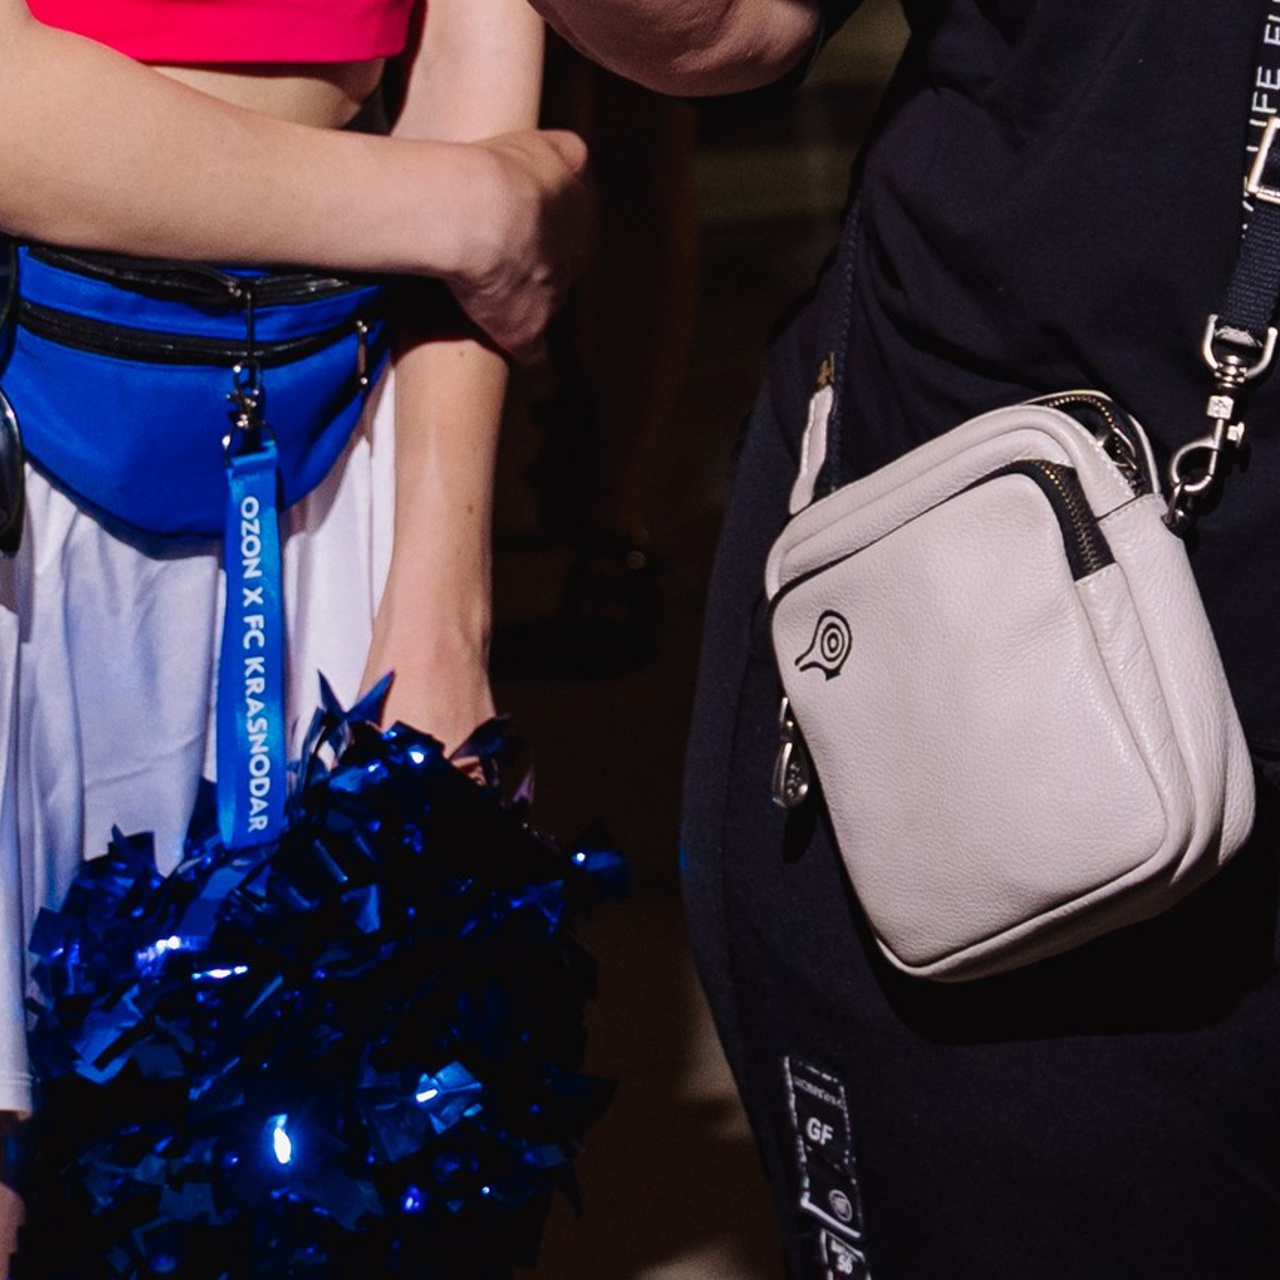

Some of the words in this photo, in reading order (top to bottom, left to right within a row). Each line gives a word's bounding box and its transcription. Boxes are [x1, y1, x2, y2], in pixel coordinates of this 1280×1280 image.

[240, 495, 263, 579] OZON
[243, 586, 264, 608] X
[243, 614, 265, 650] FC
[244, 656, 271, 833] KRASNODAR
[806, 1117, 833, 1146] GF
